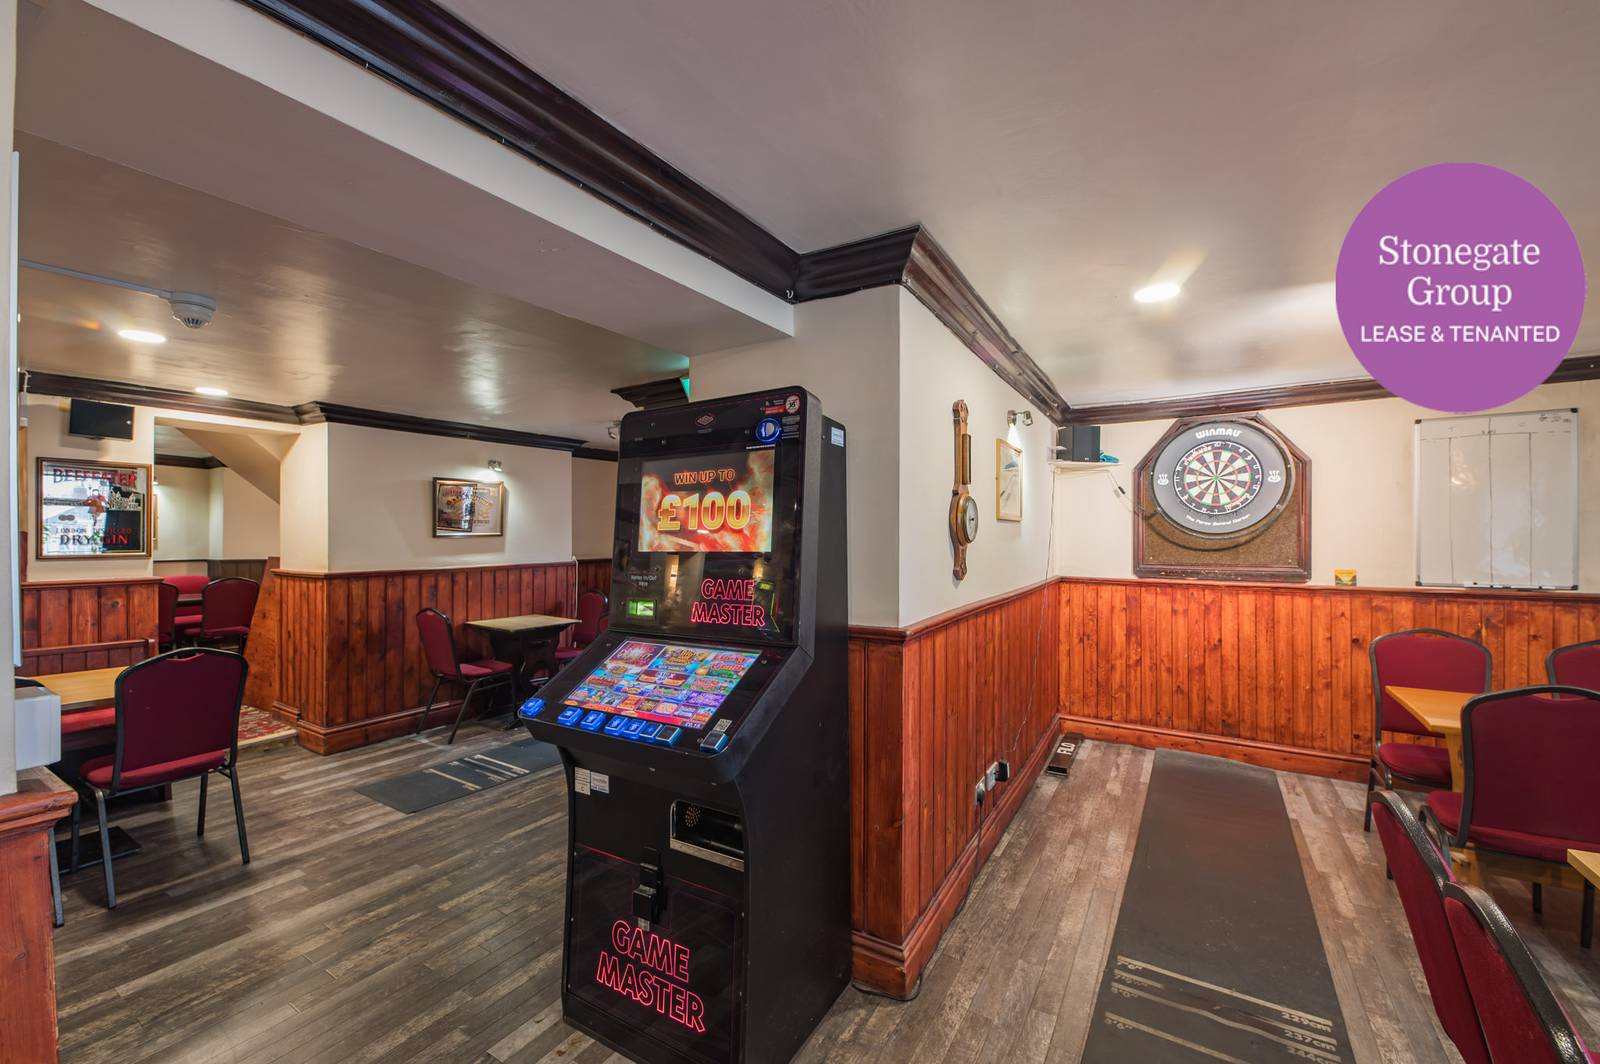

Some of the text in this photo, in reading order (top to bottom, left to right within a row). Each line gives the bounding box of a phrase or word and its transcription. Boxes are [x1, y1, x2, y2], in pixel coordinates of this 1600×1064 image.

[53, 468, 137, 488] BEEFEATER
[674, 468, 735, 485] WIN UP TO
[657, 490, 751, 531] £100
[60, 534, 129, 546] DRY GIN
[701, 578, 756, 601] GAME
[690, 602, 766, 627] MASTER
[611, 920, 690, 983] GAME
[596, 951, 706, 1033] MASTER
[1281, 1012, 1331, 1032] 229cm
[1284, 1029, 1336, 1051] 237cm
